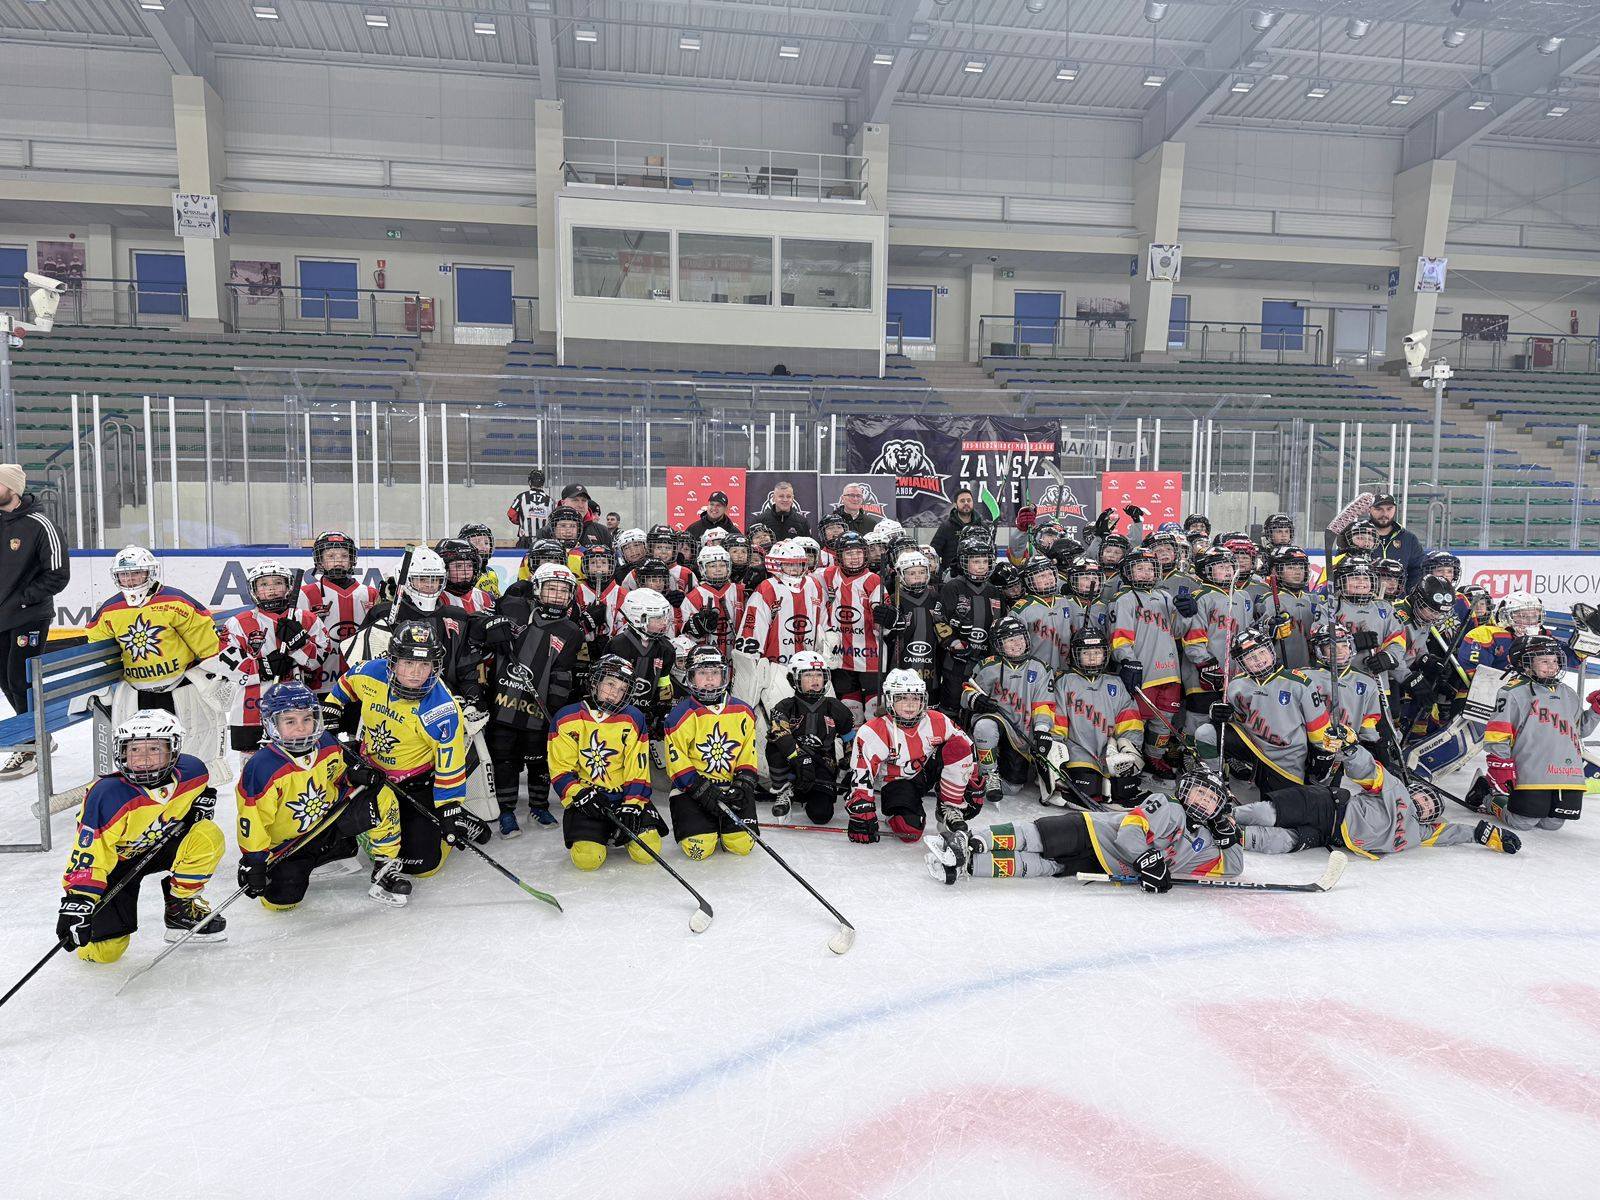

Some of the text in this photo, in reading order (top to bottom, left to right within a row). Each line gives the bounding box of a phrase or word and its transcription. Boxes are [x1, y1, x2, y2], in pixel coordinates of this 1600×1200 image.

[532, 494, 543, 502] 17
[896, 487, 913, 495] ANOK
[1473, 573, 1527, 594] GTM
[832, 625, 865, 635] CANPACK
[735, 637, 760, 651] 22
[903, 656, 933, 664] CANPACK
[1469, 651, 1480, 662] 2
[125, 658, 181, 678] PODHALE
[370, 702, 405, 724] PODHALE
[98, 723, 109, 775] BAUER
[1419, 737, 1444, 755] BAUER
[436, 747, 454, 768] 17
[485, 762, 495, 793] CCM
[1554, 807, 1580, 815] CCM
[239, 817, 250, 838] 9
[66, 850, 95, 874] 58
